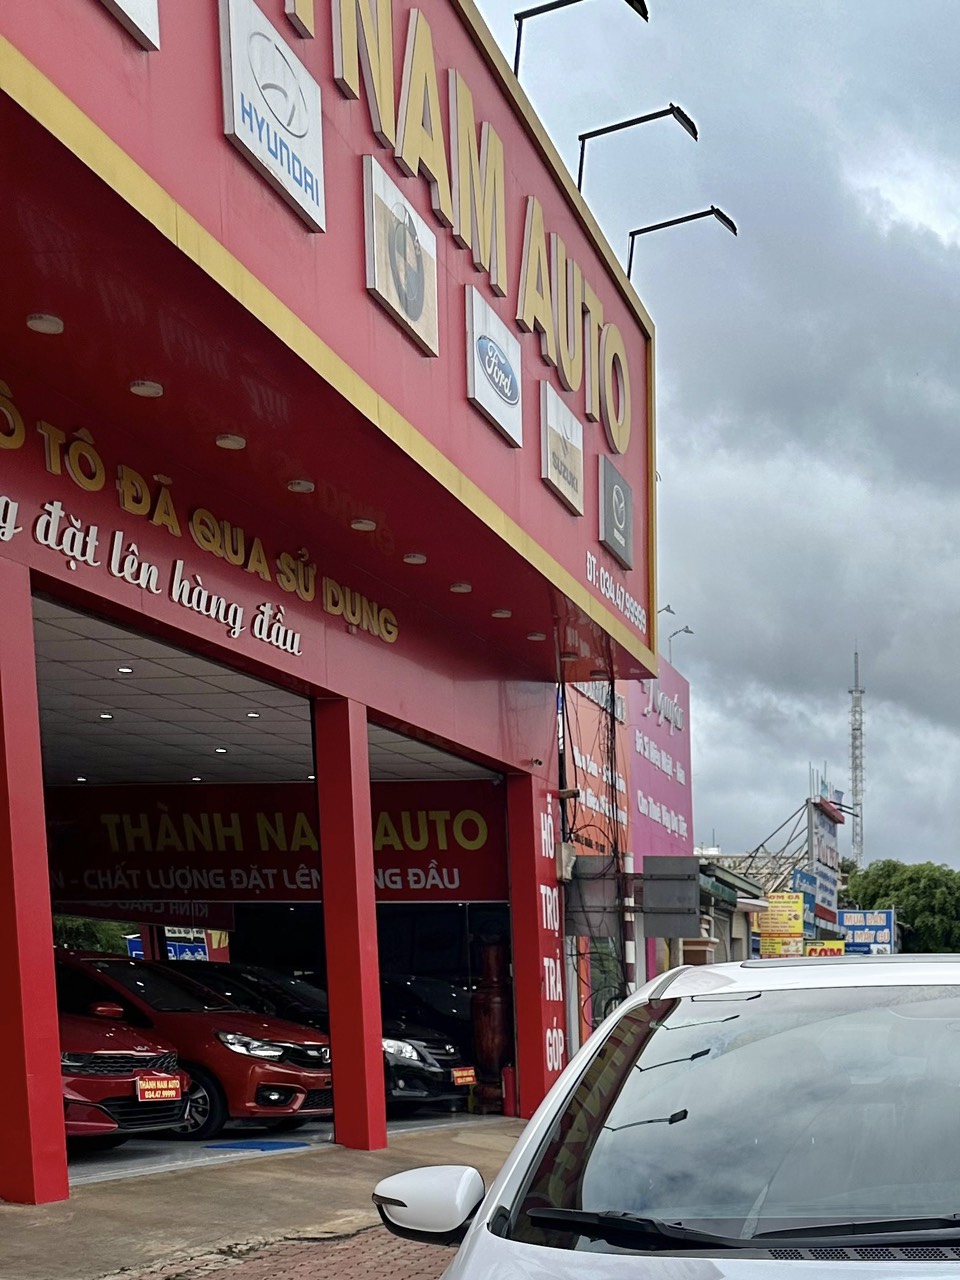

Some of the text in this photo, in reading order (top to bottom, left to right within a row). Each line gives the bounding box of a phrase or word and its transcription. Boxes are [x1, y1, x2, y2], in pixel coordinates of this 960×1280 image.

[240, 92, 320, 207] HYUNDAI
[516, 195, 631, 455] AUTO
[485, 341, 513, 398] Ford
[551, 451, 579, 495] SUZUKI
[36, 419, 106, 491] TÔ
[116, 464, 182, 537] ĐÃ
[188, 508, 272, 582] QUA
[275, 547, 317, 603] SỬ
[322, 575, 399, 644] DỤNG
[34, 501, 100, 571] đặt
[108, 531, 162, 595] lên
[169, 559, 246, 639] hàng
[252, 602, 302, 657] đầu
[100, 802, 489, 852] THÀNH NA AUTO
[540, 792, 555, 860] HỖ
[84, 861, 141, 890] CHẤT
[147, 866, 225, 895] LƯỢNG
[230, 864, 279, 894] ĐẶT
[407, 859, 460, 890] ĐẦU
[540, 884, 560, 937] TRỢ
[844, 911, 886, 926] MUA BÁN
[854, 929, 876, 943] MÁY
[543, 949, 563, 1002] TRẢ
[546, 1016, 565, 1072] GÓP
